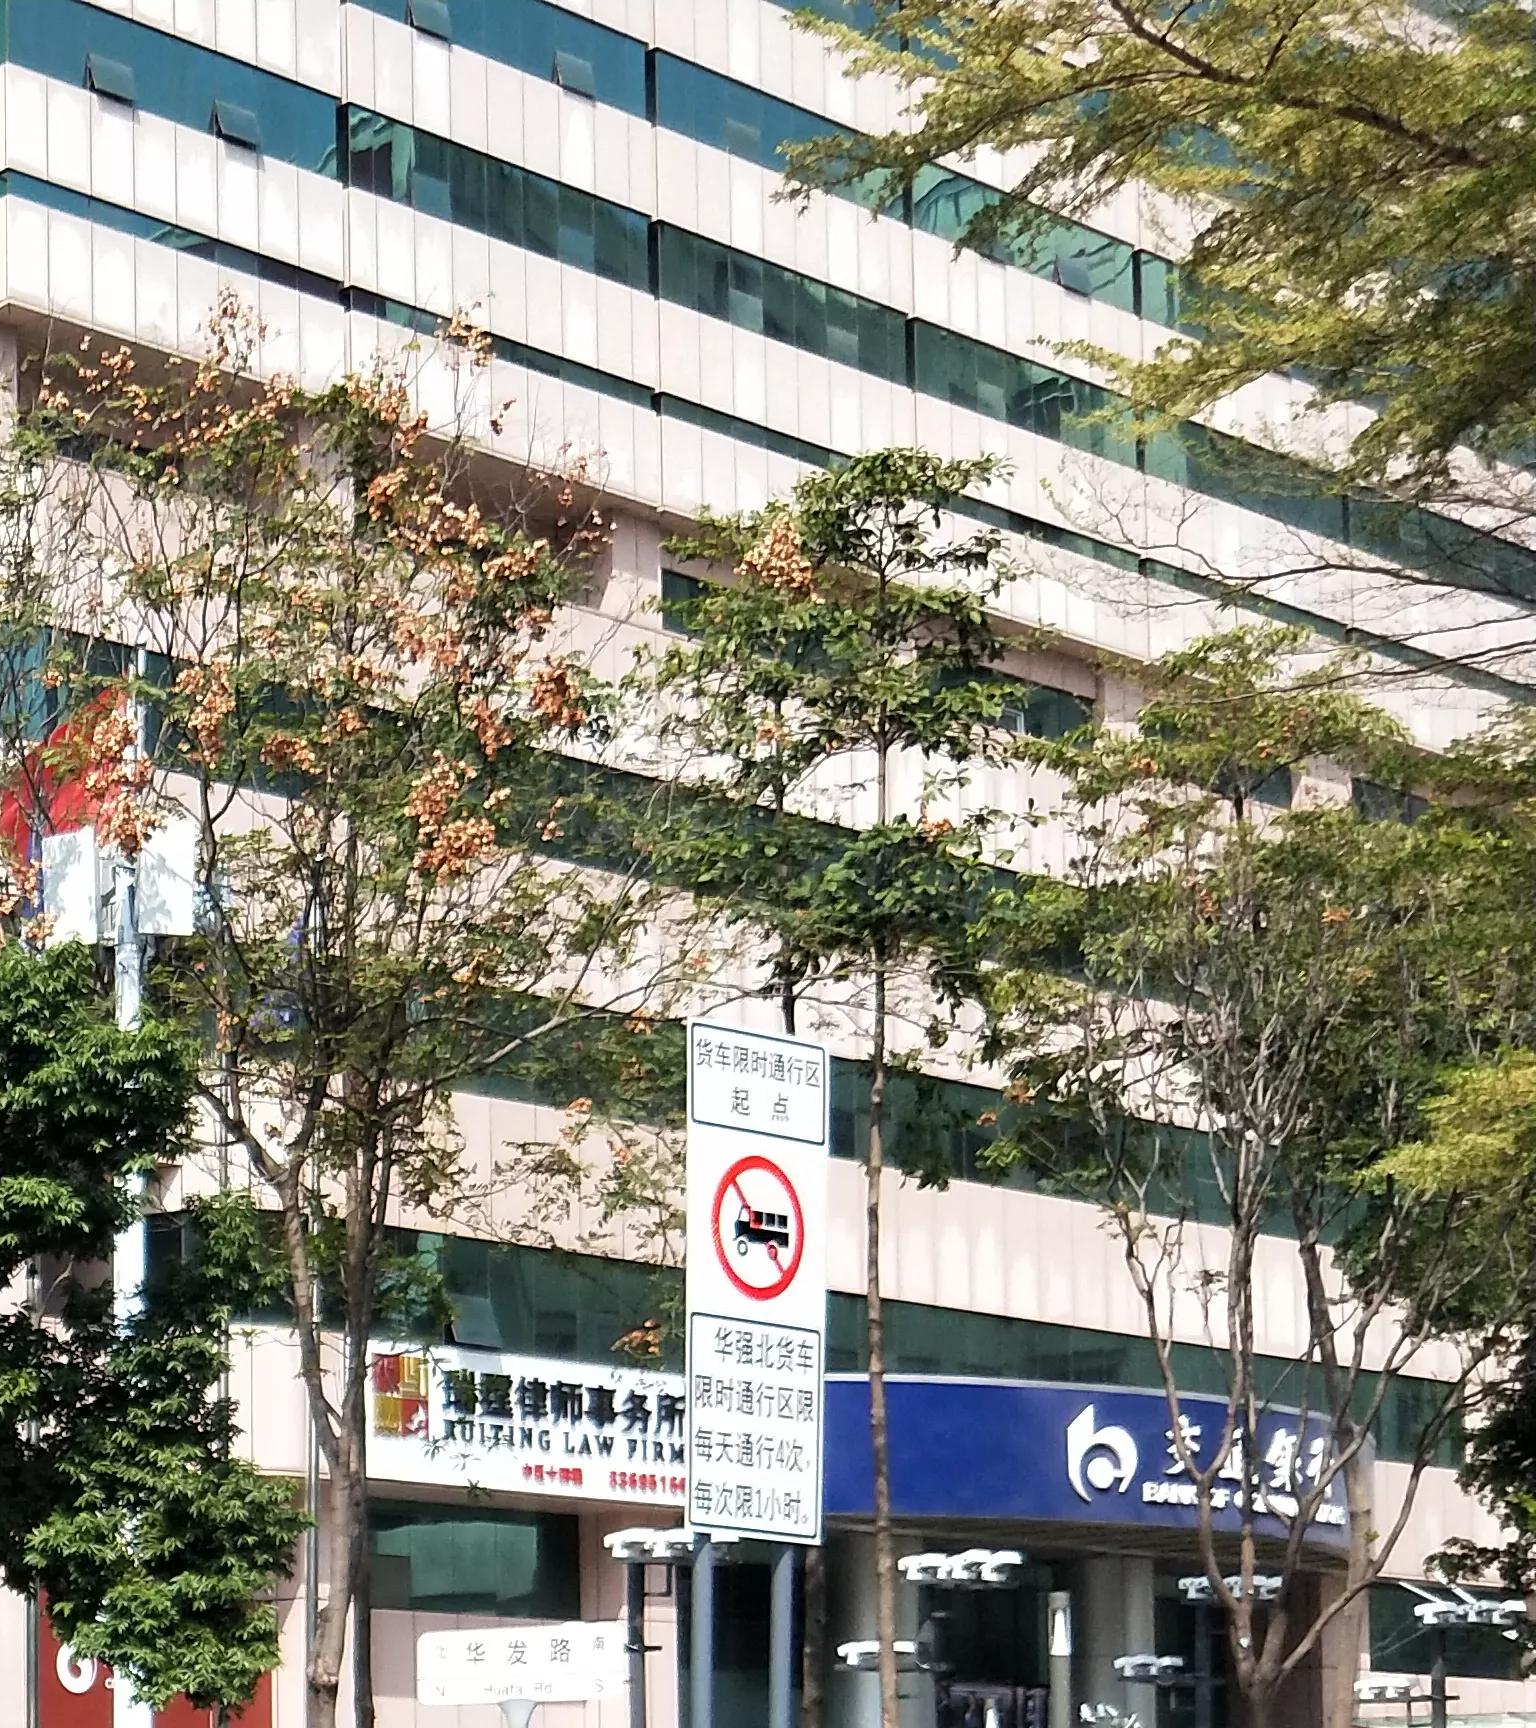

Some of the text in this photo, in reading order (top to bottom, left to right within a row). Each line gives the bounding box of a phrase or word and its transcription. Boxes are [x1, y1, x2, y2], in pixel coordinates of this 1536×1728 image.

[696, 1038, 821, 1088] 货车限时通行区
[714, 1325, 814, 1375] 华强北货车
[694, 1374, 814, 1422] 限时通行区限
[563, 1430, 614, 1458] LAW
[627, 1438, 686, 1465] FIRM
[466, 1638, 571, 1666] 华发路
